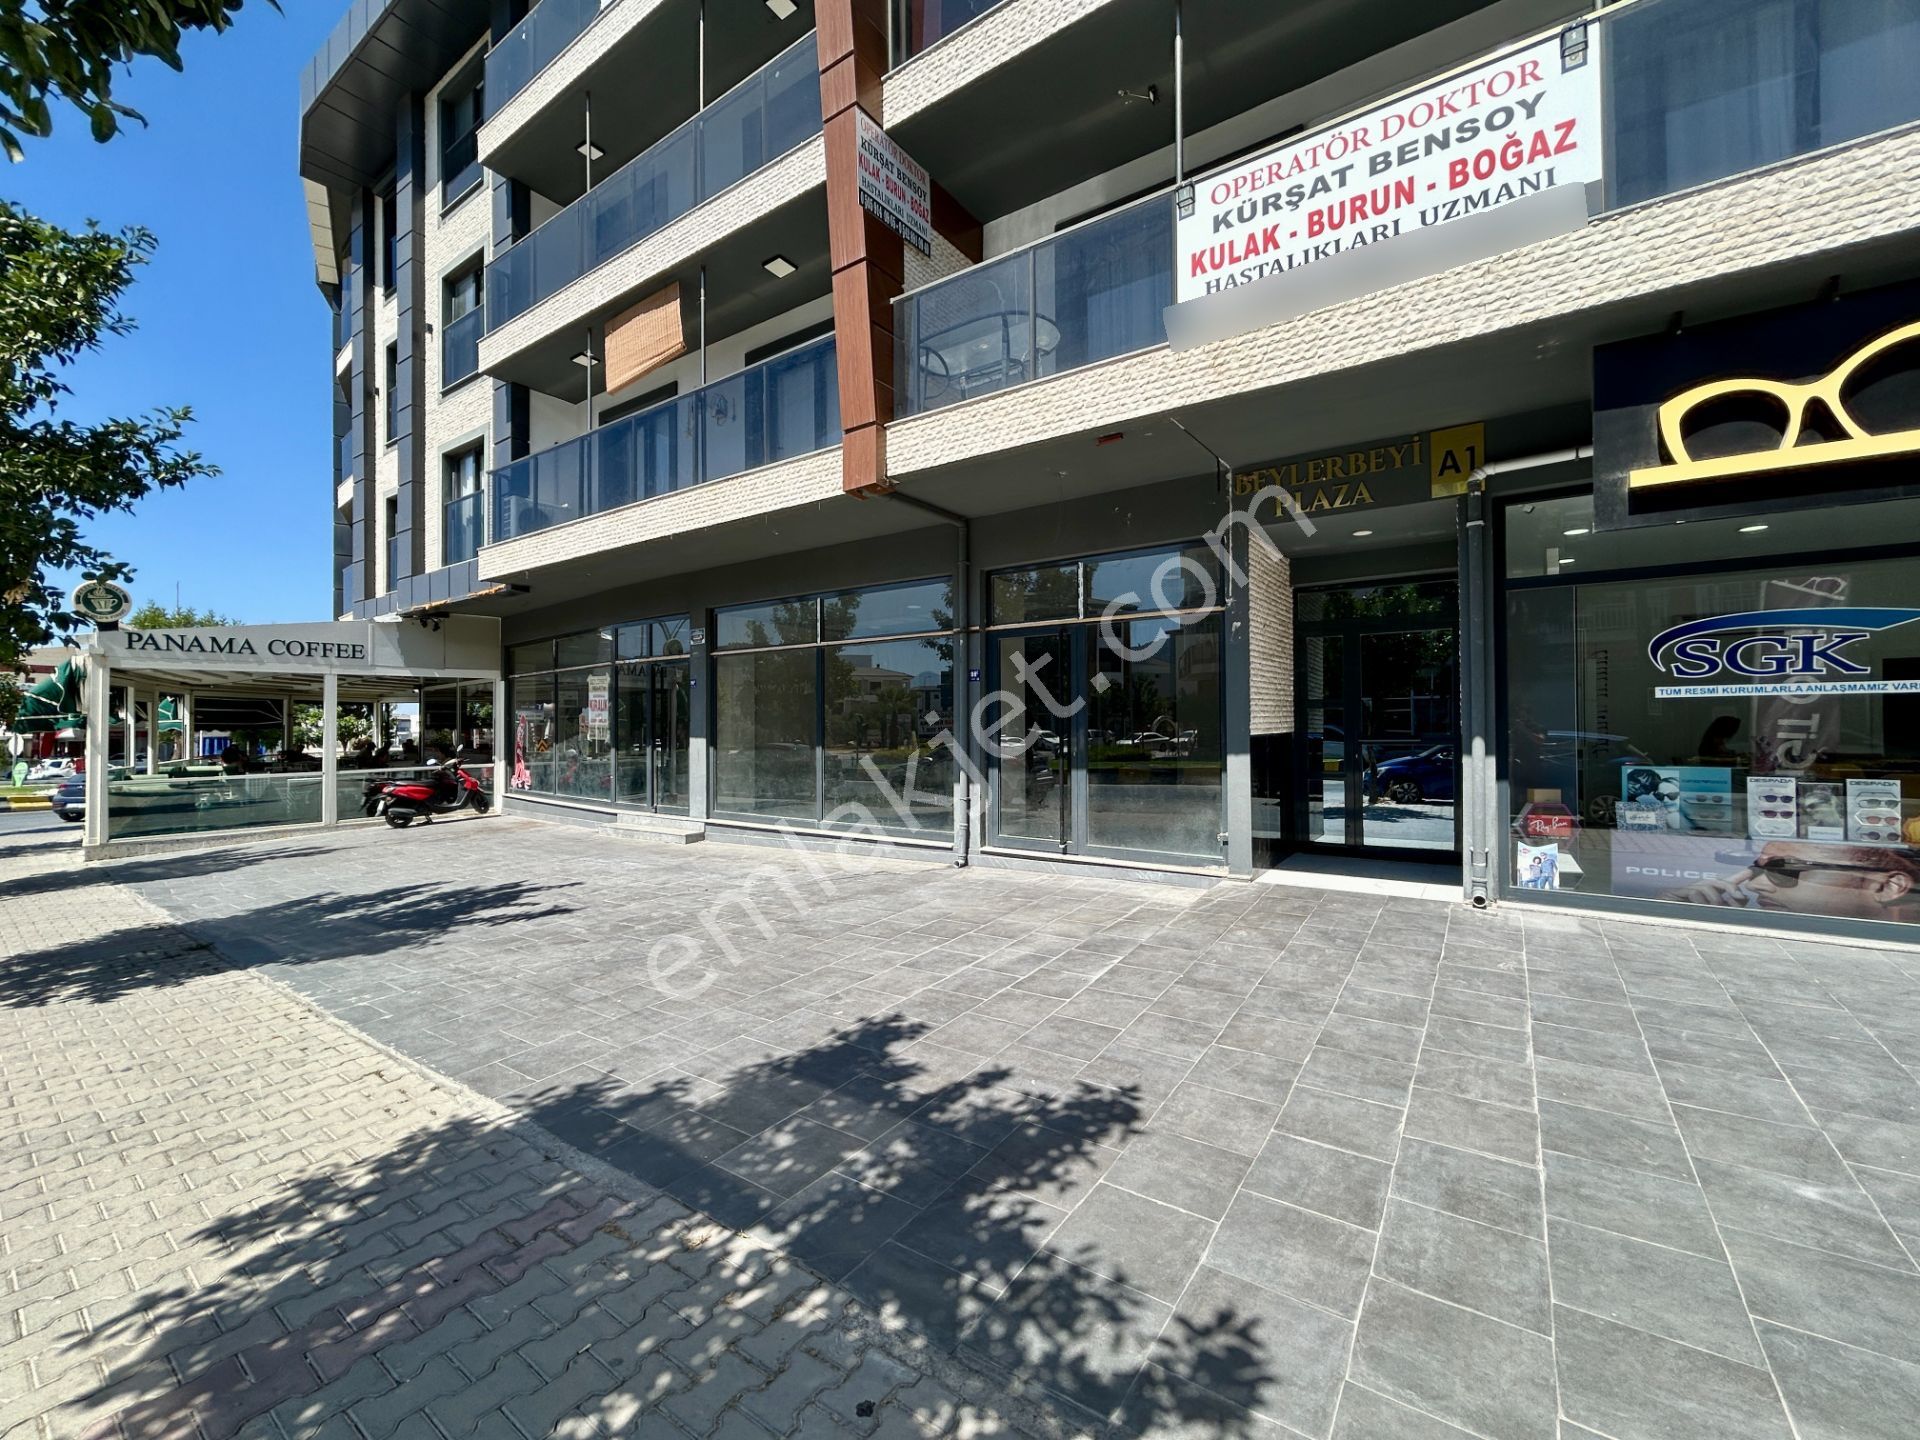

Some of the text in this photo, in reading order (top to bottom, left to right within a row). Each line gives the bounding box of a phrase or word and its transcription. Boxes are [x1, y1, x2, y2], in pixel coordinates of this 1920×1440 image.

[1210, 59, 1544, 205] OPERATÖR DOKTOR
[1212, 90, 1547, 234] KÜRŞAT BENSOY
[1190, 223, 1280, 278] KULAK
[1308, 175, 1415, 239] BURUN
[1449, 118, 1578, 192] BOĞAZ
[1419, 166, 1557, 227] UZMANI
[1233, 436, 1424, 497] BEYLERBEYİ
[1437, 445, 1478, 477] A1
[1274, 481, 1375, 518] PLAZA
[125, 631, 366, 660] PANAMA COFFEE
[1671, 633, 1871, 679] SGK
[1659, 682, 1920, 696] TÜM RESMİ KURUMLARLA ANLAŞMAMIZ VAR
[1625, 866, 1718, 880] POLICE
